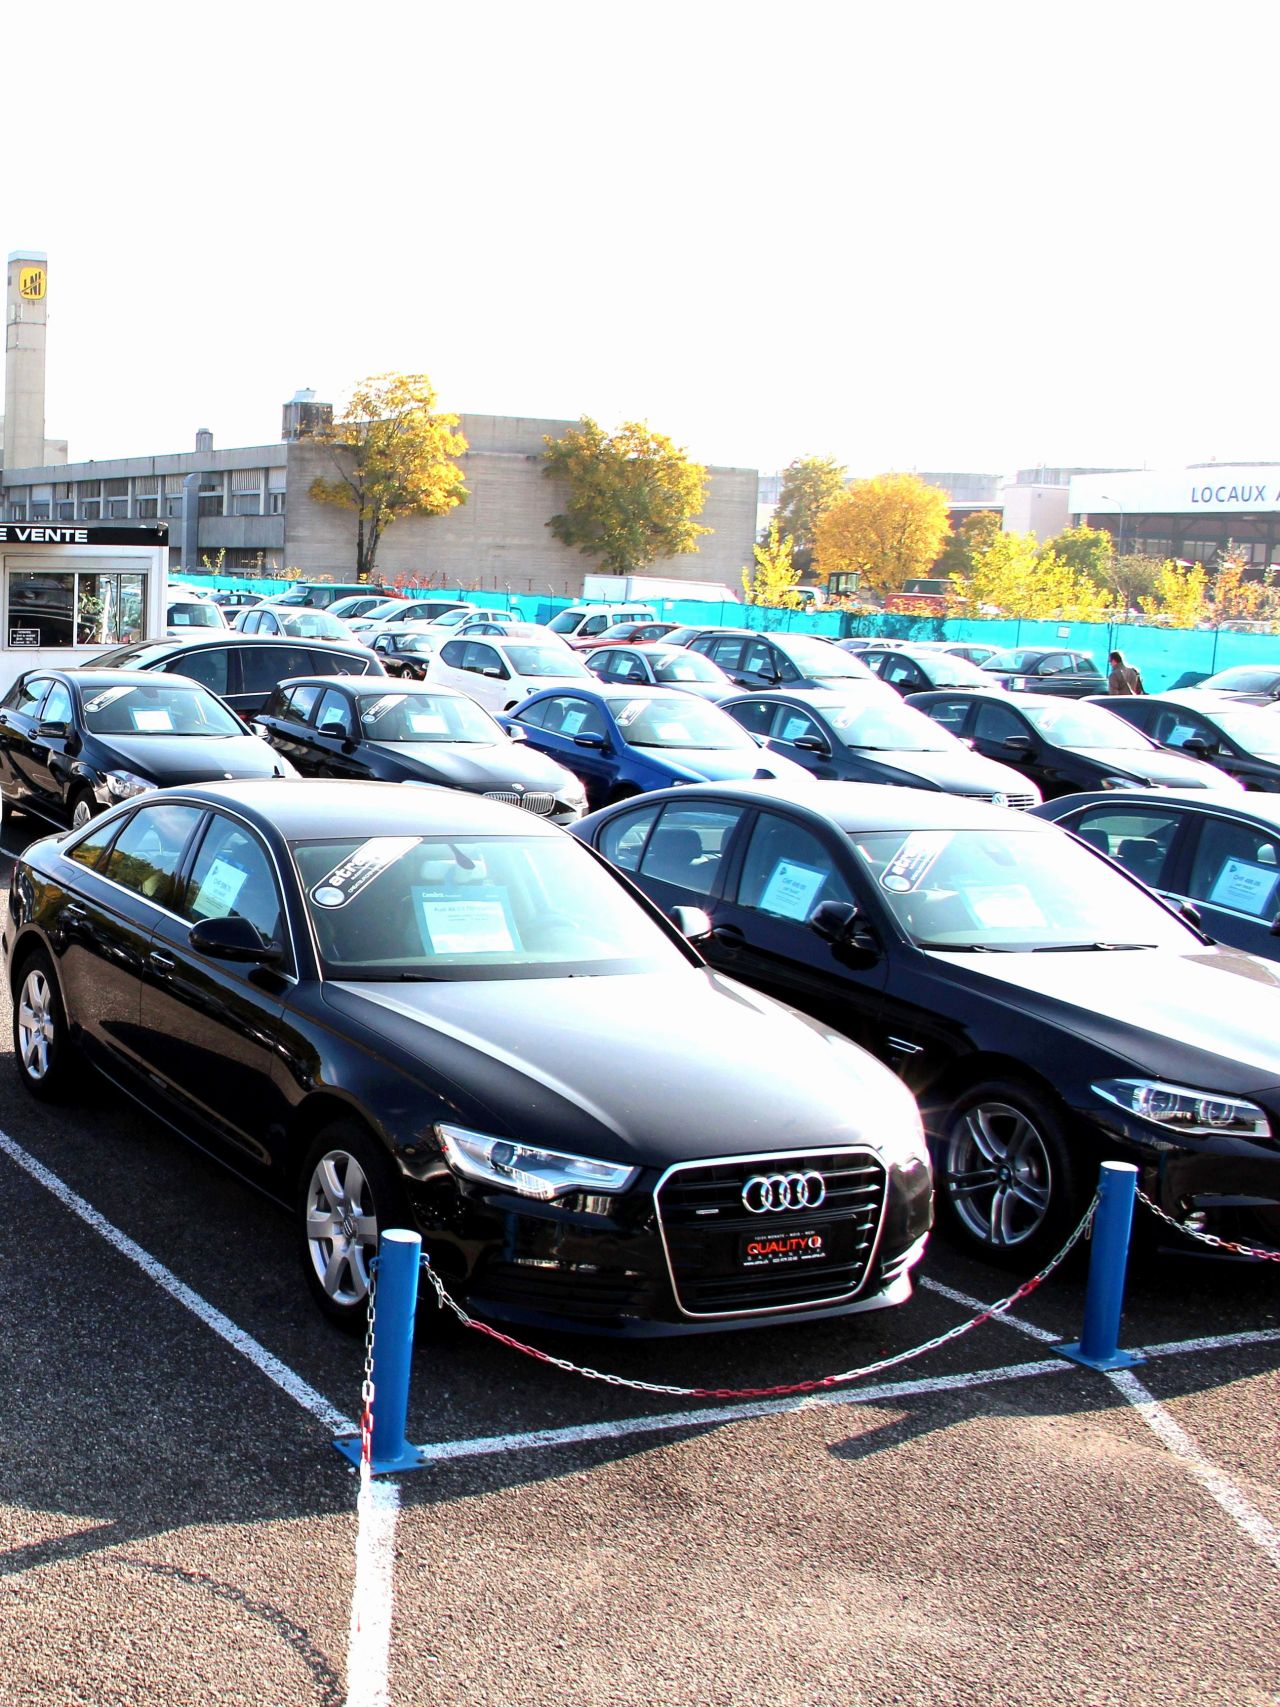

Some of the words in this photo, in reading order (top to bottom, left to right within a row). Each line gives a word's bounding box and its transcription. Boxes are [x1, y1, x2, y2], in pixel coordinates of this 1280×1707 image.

[1191, 485, 1266, 502] LOCAUX
[16, 528, 88, 543] VENTE
[747, 1237, 808, 1255] QUALITY
